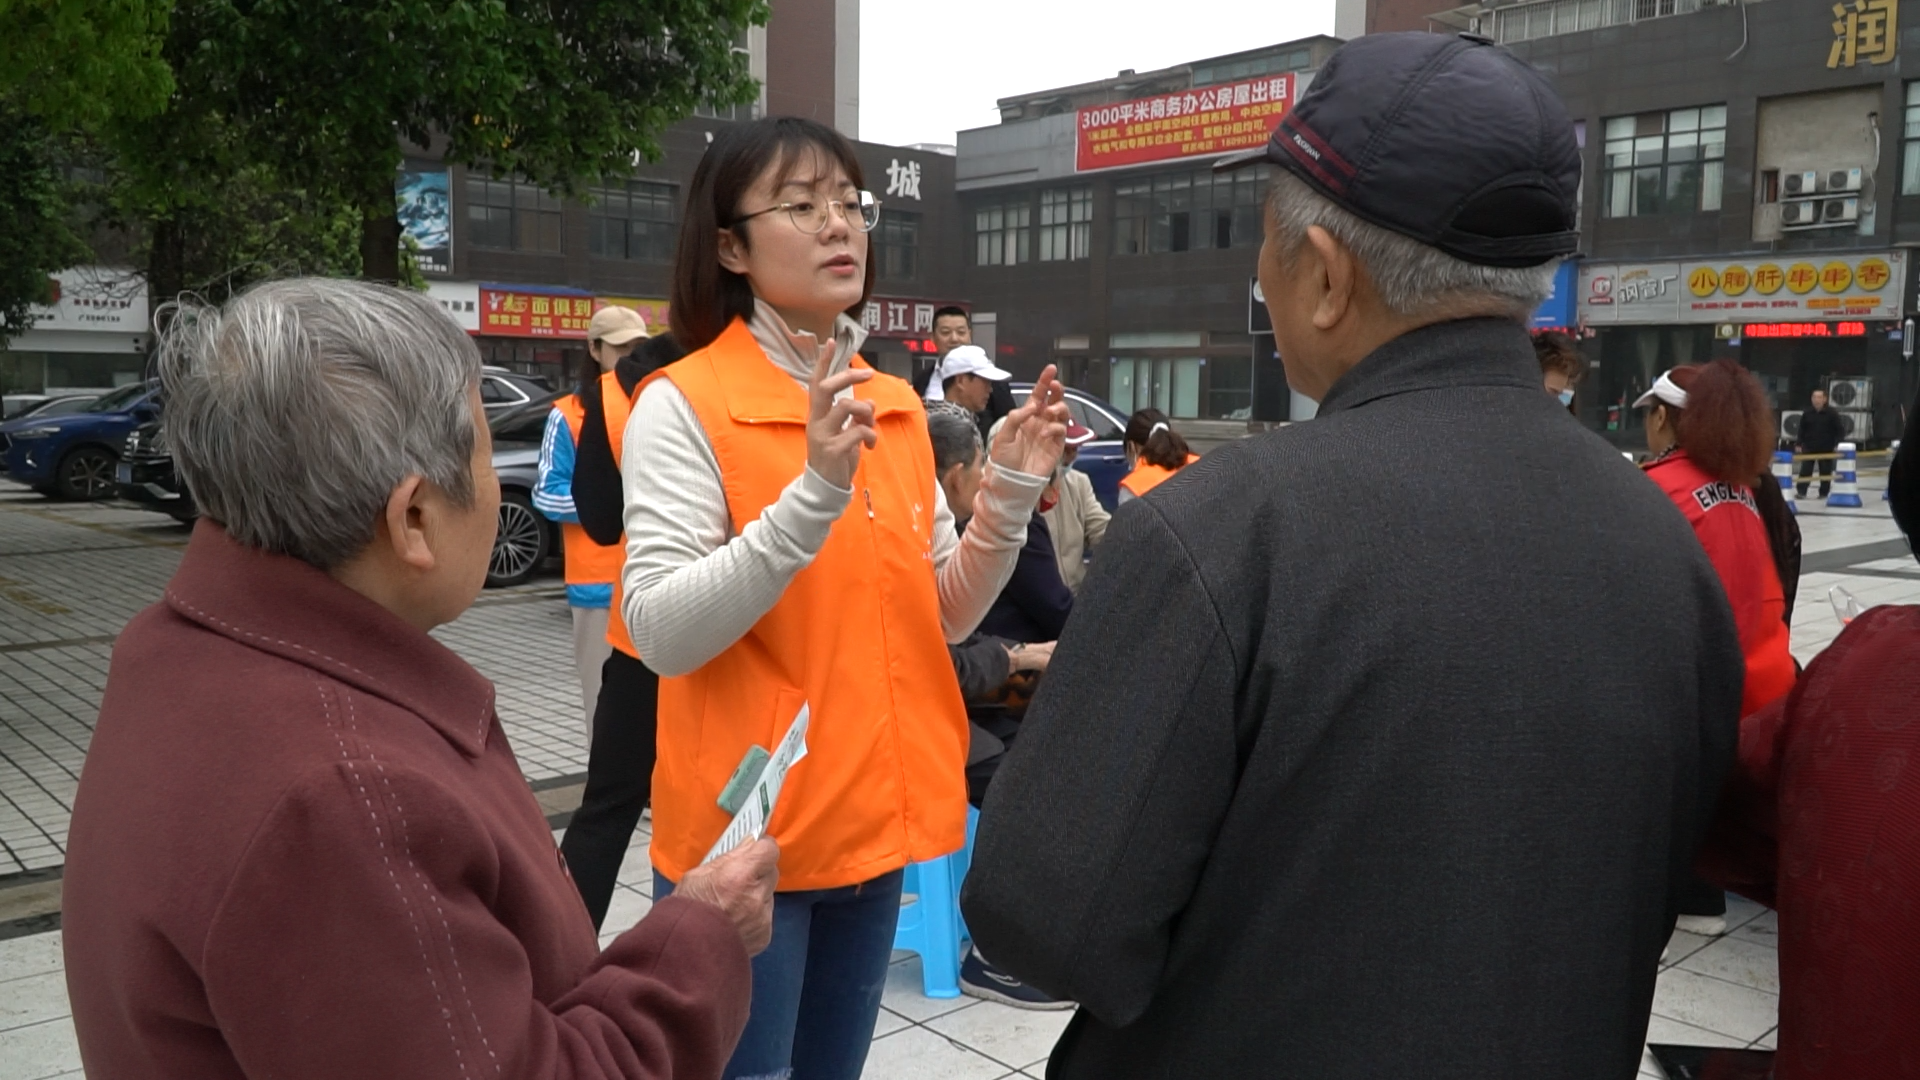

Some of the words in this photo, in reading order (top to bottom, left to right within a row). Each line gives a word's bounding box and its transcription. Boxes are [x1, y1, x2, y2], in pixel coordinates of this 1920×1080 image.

[1827, 0, 1898, 68] 润
[1082, 77, 1287, 129] 3000平米商务办公房屋出租
[886, 159, 921, 200] 城
[1619, 275, 1678, 303] 钢管厂
[861, 302, 934, 333] 润江网
